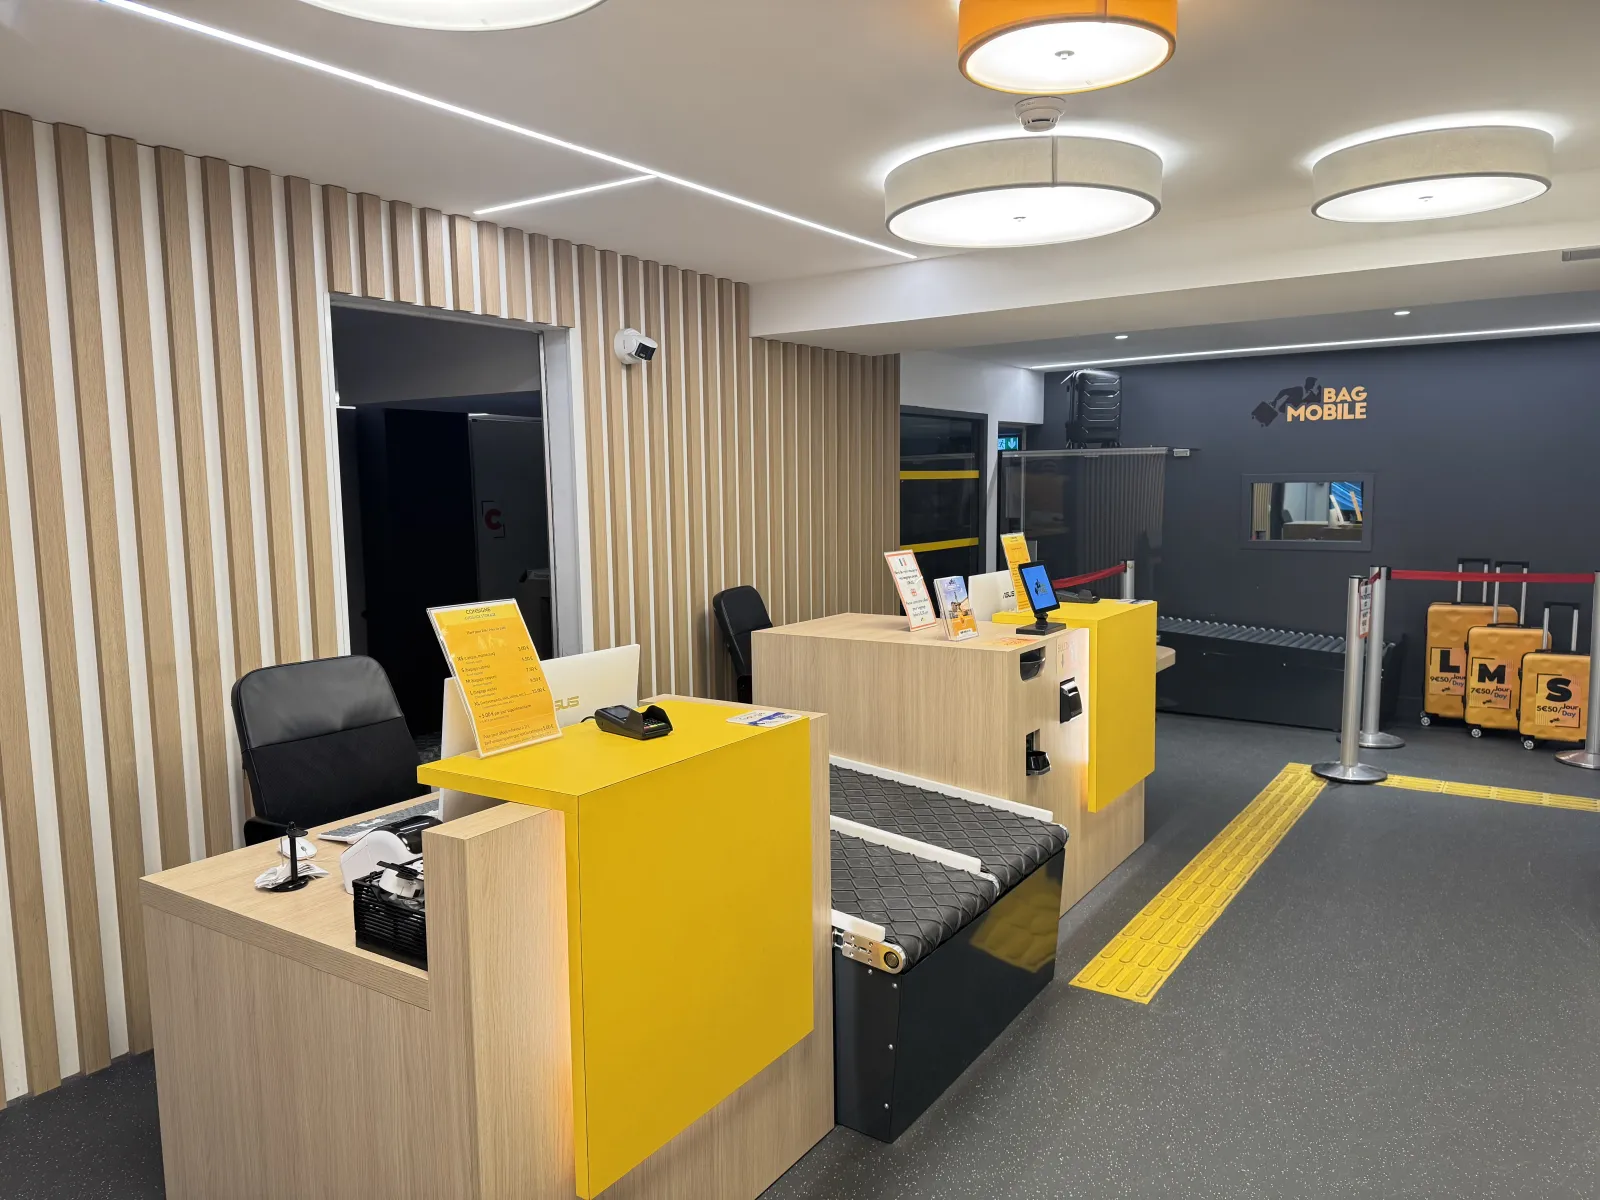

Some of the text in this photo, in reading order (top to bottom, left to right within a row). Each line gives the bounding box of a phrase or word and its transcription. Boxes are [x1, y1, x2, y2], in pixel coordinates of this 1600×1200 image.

[1323, 386, 1368, 403] BAG
[1287, 403, 1367, 422] MOBILE
[1440, 650, 1460, 673] L
[1478, 664, 1506, 684] M
[1452, 680, 1465, 688] Day
[1546, 678, 1572, 702] S
[1494, 692, 1508, 701] Day
[1562, 710, 1577, 719] Day
